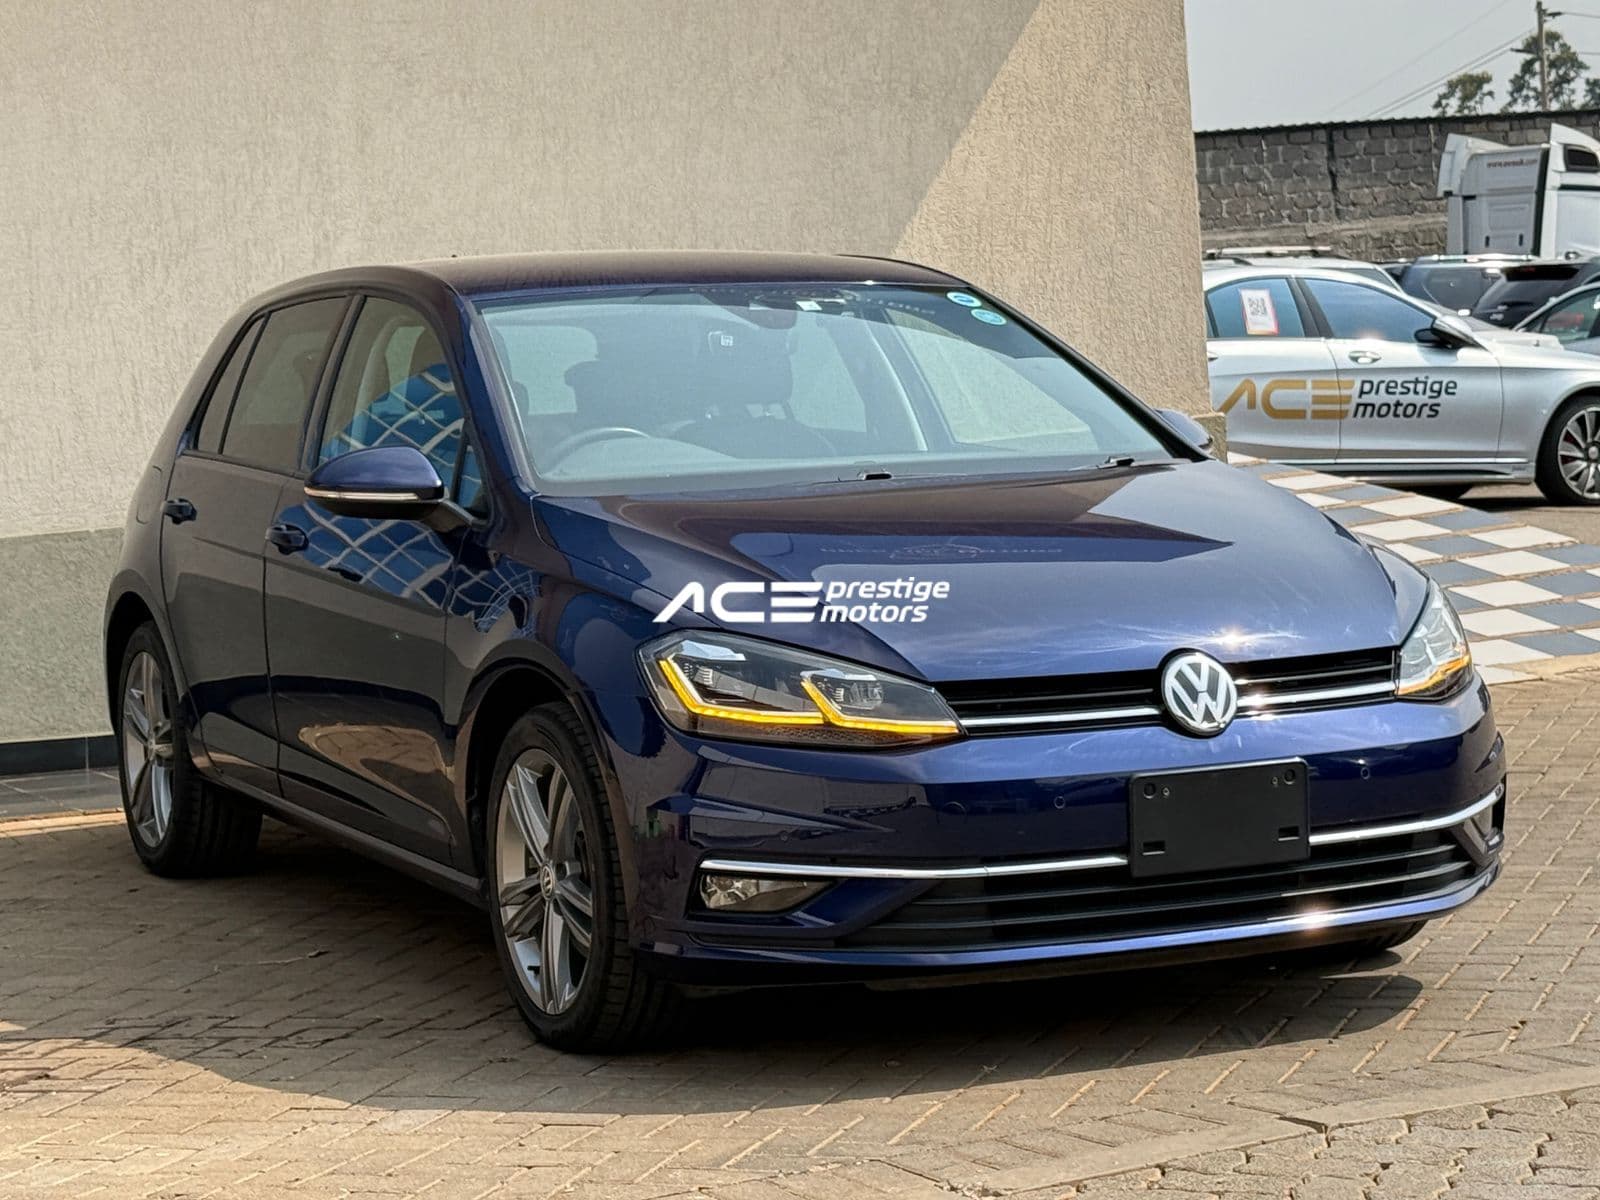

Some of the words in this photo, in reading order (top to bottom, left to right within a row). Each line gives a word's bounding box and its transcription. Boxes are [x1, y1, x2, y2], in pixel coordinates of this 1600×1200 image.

[1218, 378, 1355, 420] ACE
[1358, 376, 1457, 399] prestige
[1353, 400, 1441, 419] motors
